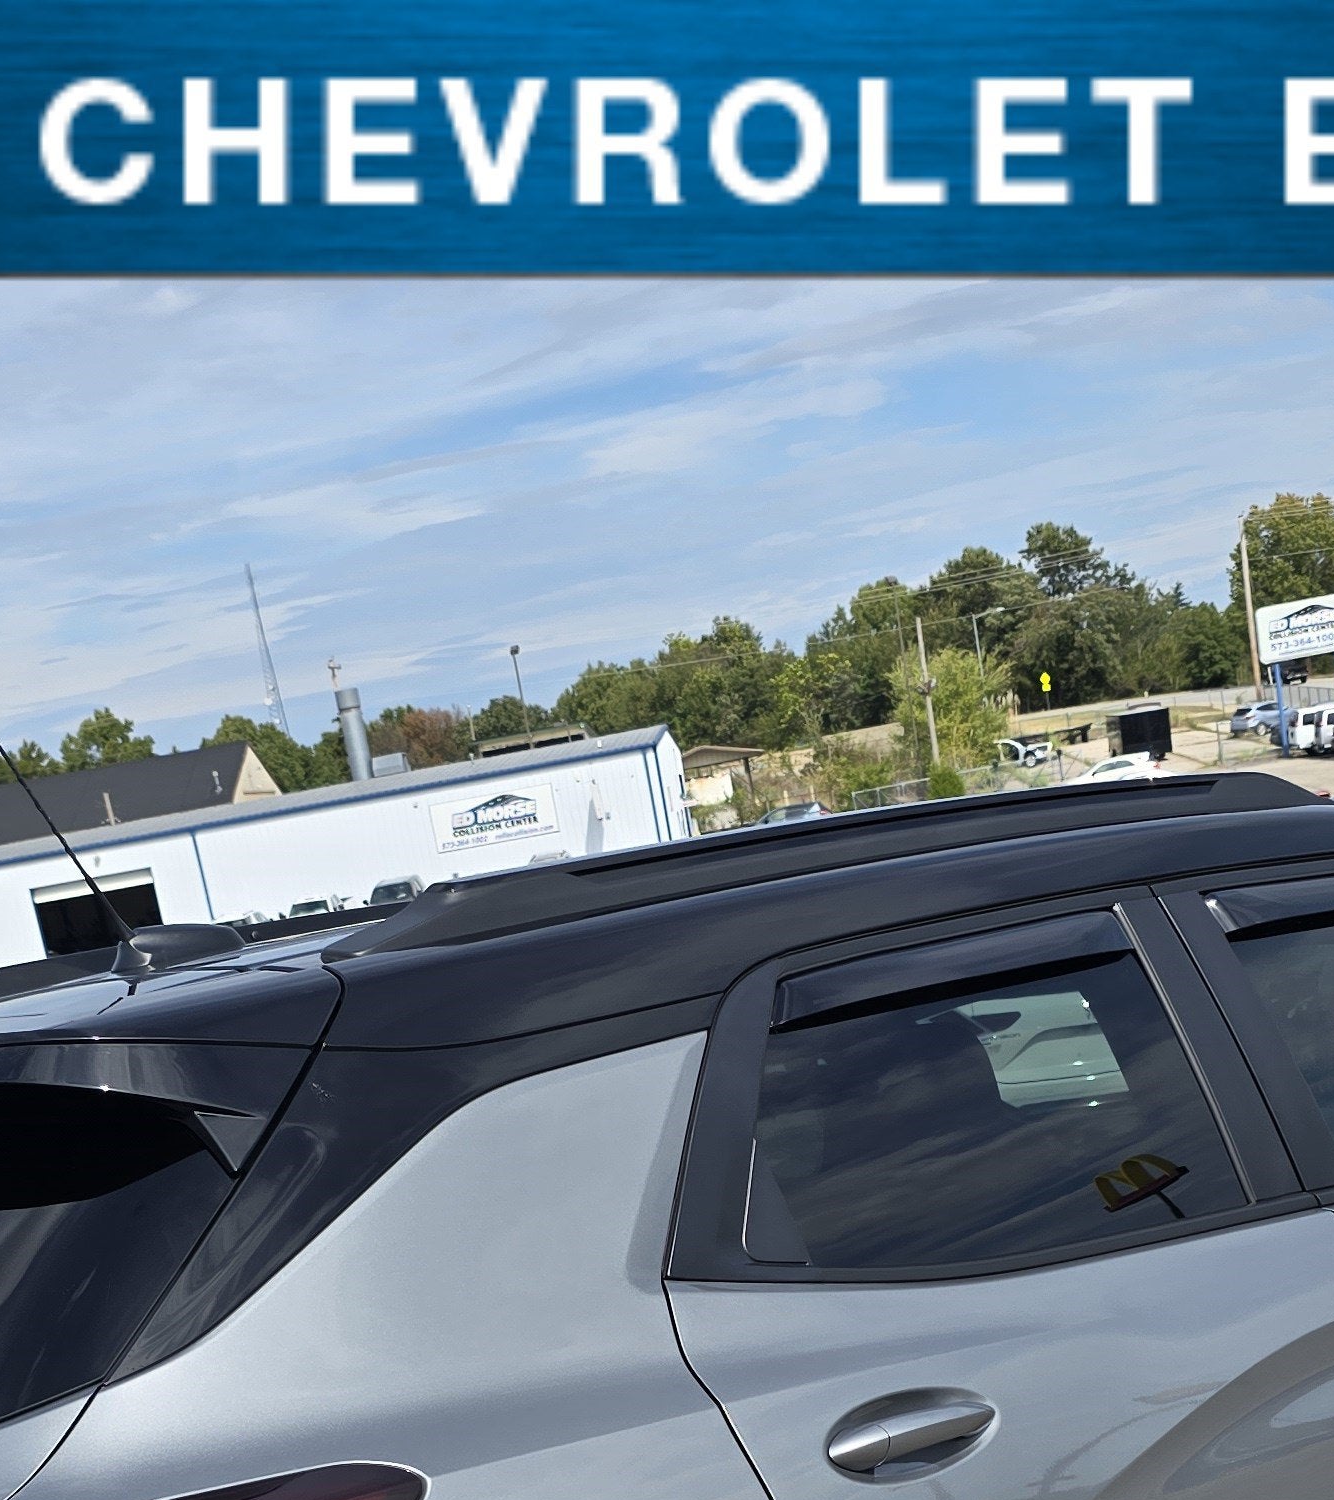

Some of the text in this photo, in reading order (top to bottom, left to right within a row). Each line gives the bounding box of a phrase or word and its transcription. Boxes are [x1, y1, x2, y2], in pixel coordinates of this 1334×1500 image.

[452, 815, 540, 838] COLLISION CENTER
[453, 800, 537, 828] ED MORSE
